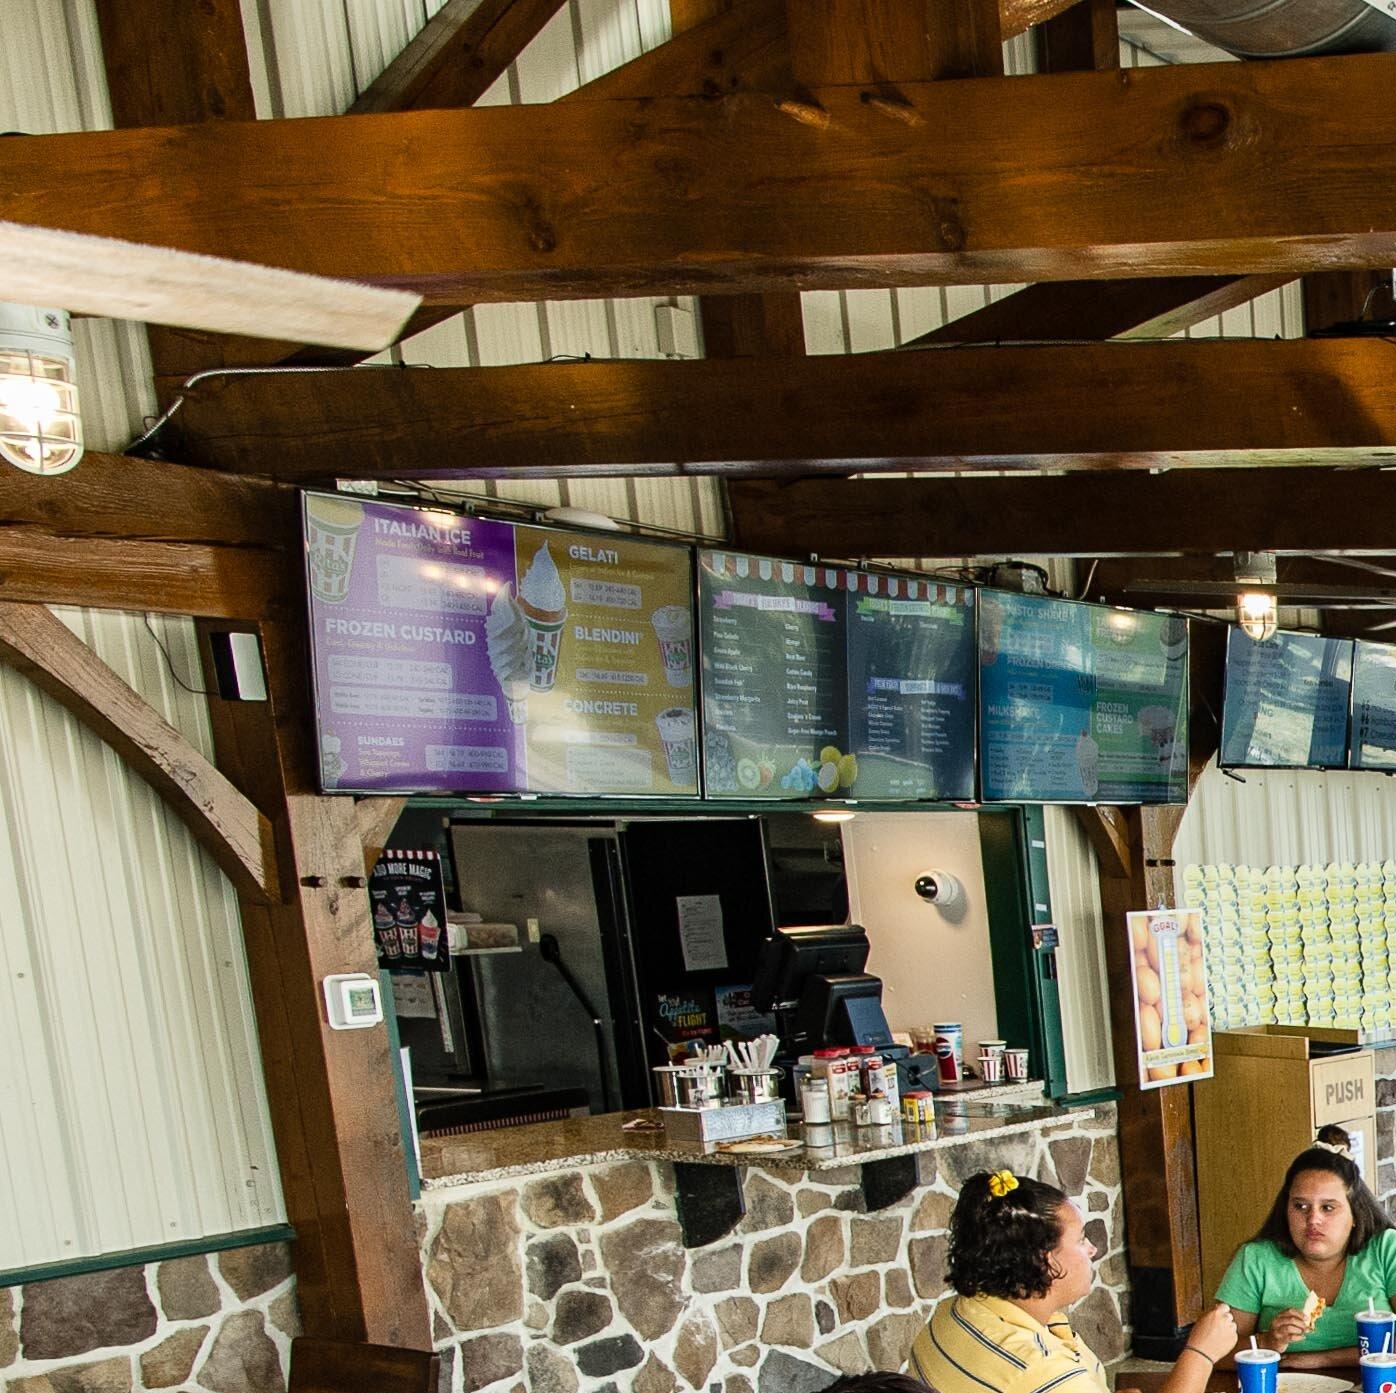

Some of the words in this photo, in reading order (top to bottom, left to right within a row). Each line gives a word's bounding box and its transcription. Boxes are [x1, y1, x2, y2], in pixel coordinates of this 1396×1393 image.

[374, 518, 440, 541] ITALIAN
[446, 528, 472, 546] ICE
[569, 545, 619, 565] GELATI
[325, 618, 396, 638] FROZEN
[400, 624, 476, 645] CUSTARD
[563, 699, 638, 716] CONCRETE
[1096, 702, 1128, 713] FROZEN
[1096, 713, 1133, 725] CUSTARD
[1096, 724, 1123, 735] CAKES
[357, 735, 405, 747] SUNDAES
[388, 862, 408, 875] MORE
[408, 863, 433, 881] MAGIC
[678, 1013, 707, 1028] FLIGHT
[1325, 1079, 1364, 1105] PUSH
